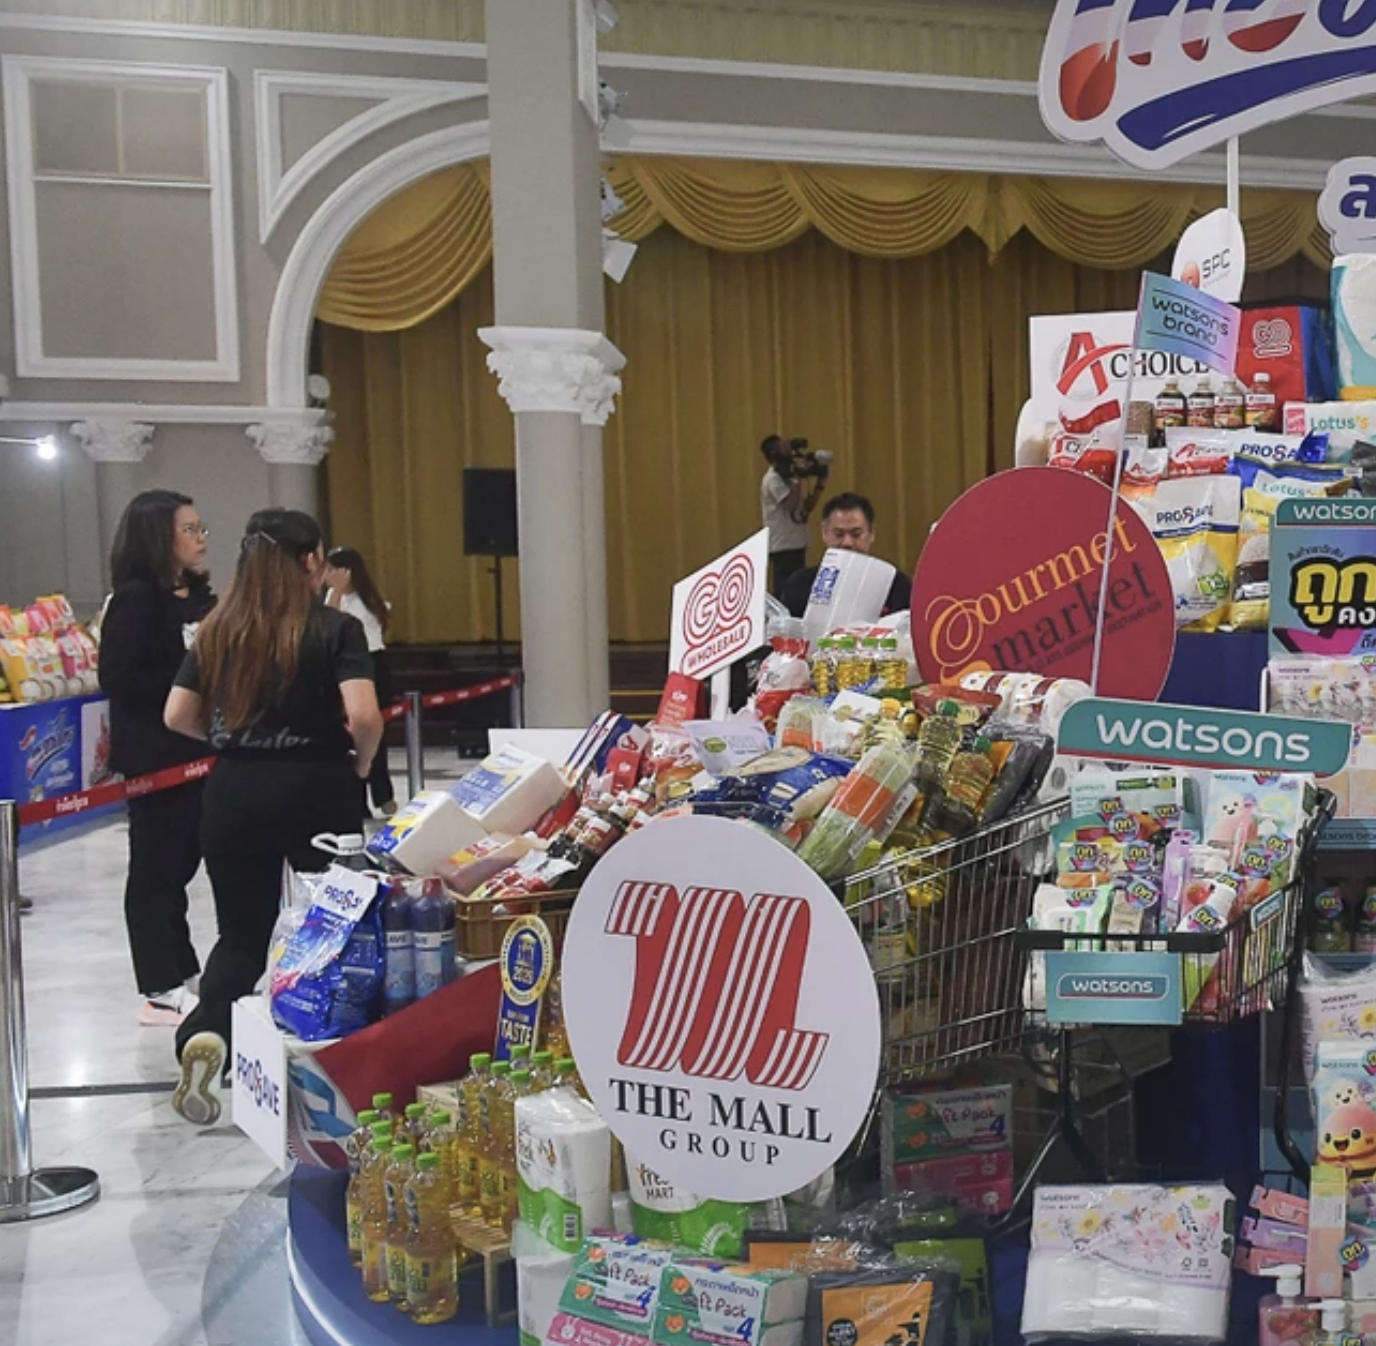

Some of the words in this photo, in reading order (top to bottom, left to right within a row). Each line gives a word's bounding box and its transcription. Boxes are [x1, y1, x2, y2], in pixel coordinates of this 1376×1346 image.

[1202, 248, 1231, 279] SPC
[1151, 296, 1229, 336] watsons
[1163, 314, 1218, 346] brand
[1310, 414, 1370, 431] Lotus's
[1240, 443, 1299, 462] PROSA
[683, 553, 755, 648] GO
[925, 516, 1138, 687] Gourmet
[991, 560, 1155, 671] market
[686, 629, 747, 668] WHOLESALE
[1095, 713, 1311, 762] watsons
[1070, 978, 1154, 995] watsons
[501, 1019, 533, 1046] TASTE
[609, 1078, 693, 1122] THE
[709, 1092, 834, 1144] MALL
[659, 1129, 781, 1166] GROUP
[624, 1268, 651, 1287] Pack
[636, 1285, 657, 1308] 4
[714, 1295, 747, 1318] Pack
[736, 1317, 755, 1342] 4
